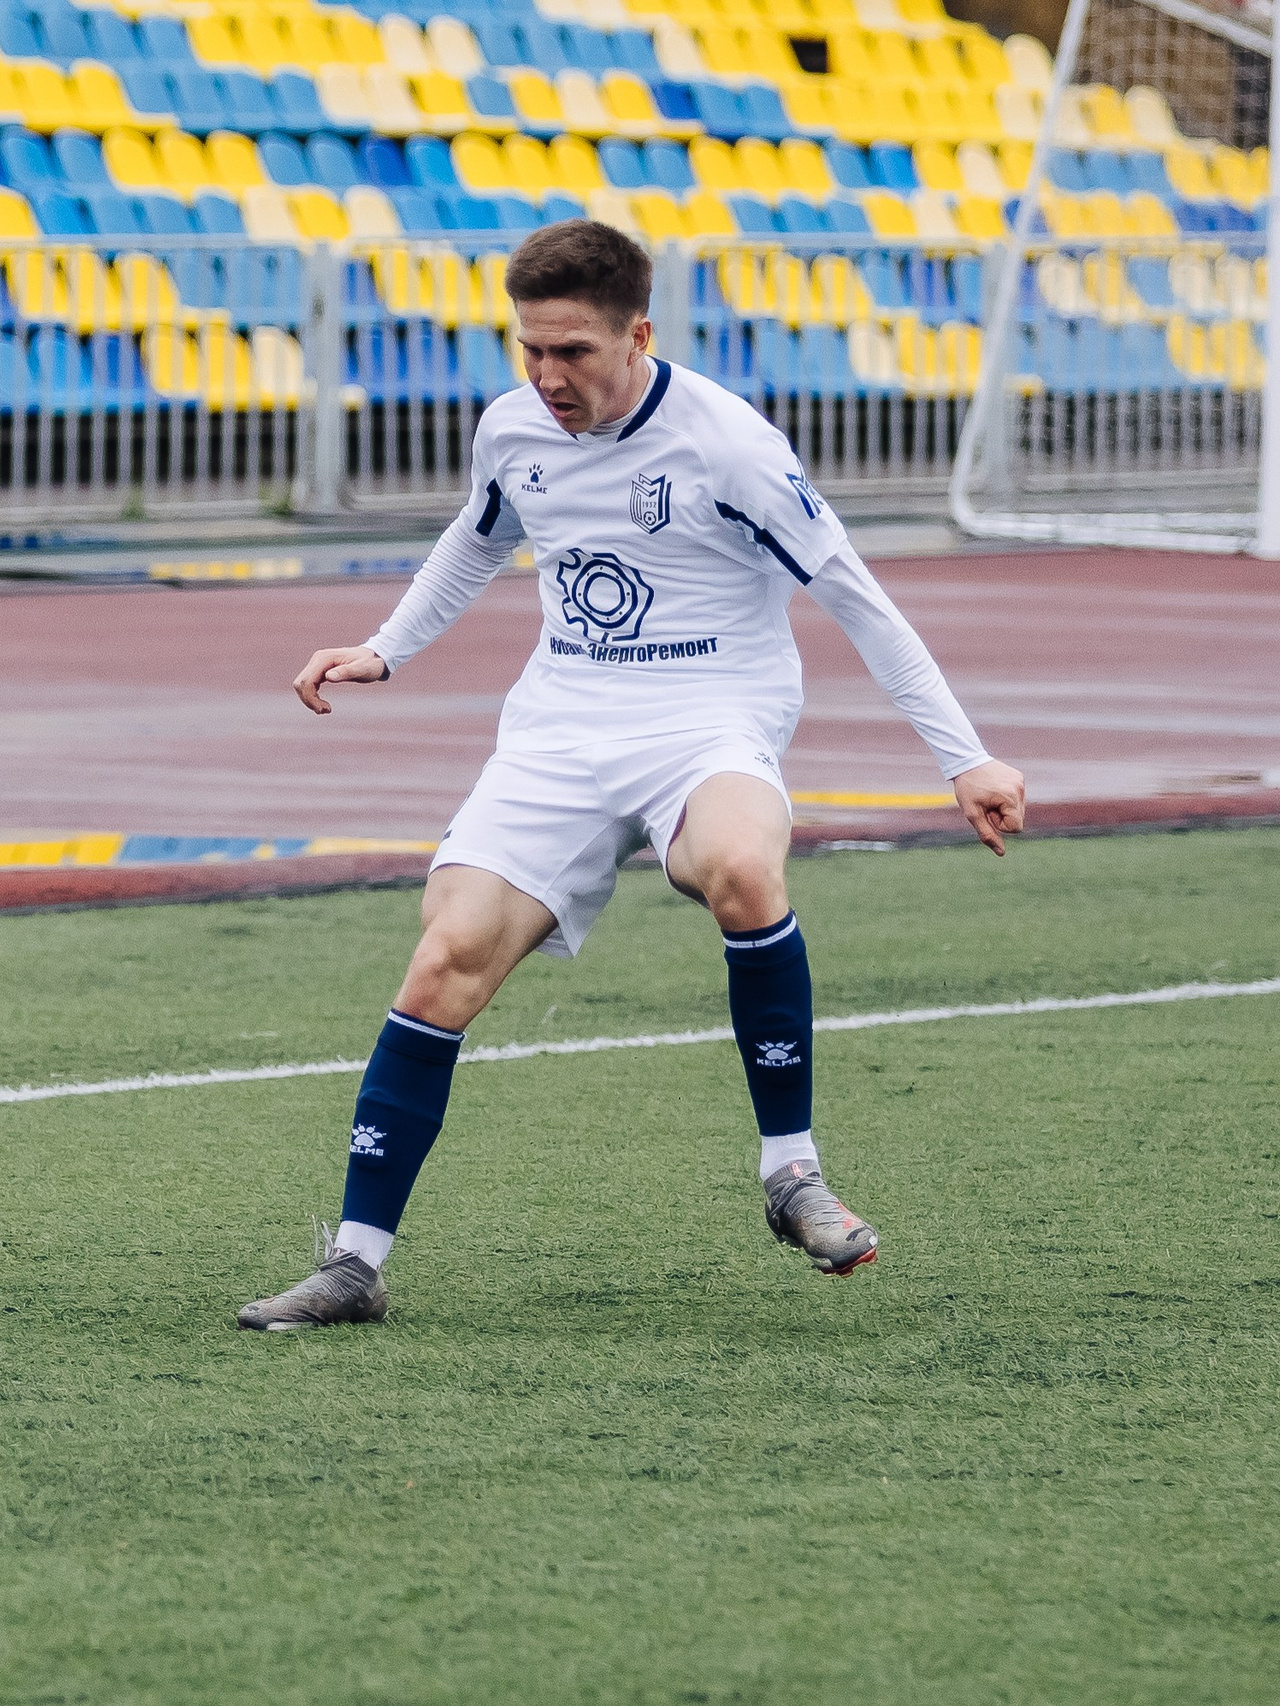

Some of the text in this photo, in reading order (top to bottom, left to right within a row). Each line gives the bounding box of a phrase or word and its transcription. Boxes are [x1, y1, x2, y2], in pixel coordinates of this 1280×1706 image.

[521, 483, 549, 495] KELME
[756, 1056, 801, 1067] KELME
[349, 1144, 384, 1156] ELME
